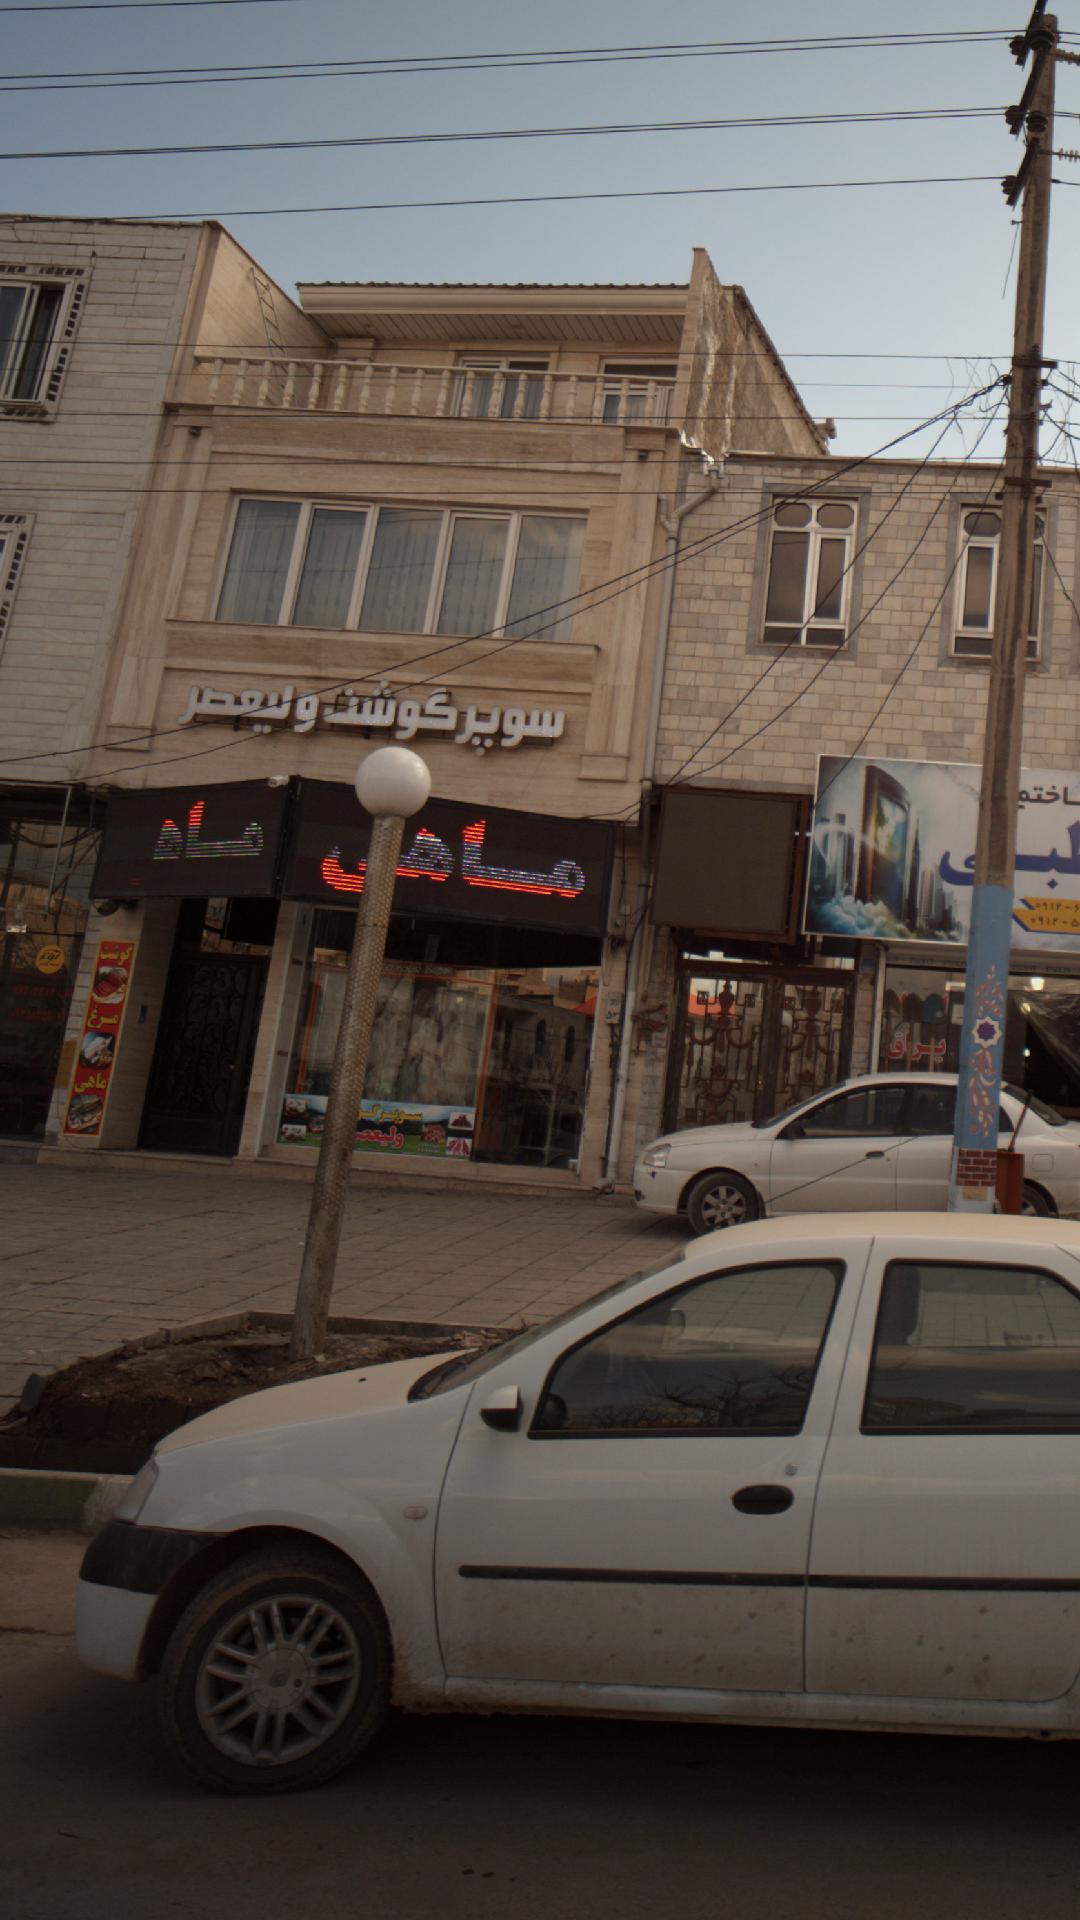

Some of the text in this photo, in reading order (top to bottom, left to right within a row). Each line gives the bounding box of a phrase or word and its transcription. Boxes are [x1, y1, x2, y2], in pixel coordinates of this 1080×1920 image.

[177, 680, 568, 757] سوپر گوشت ولیعصر
[320, 818, 587, 900] ماهی
[100, 945, 133, 966] گوشت
[88, 1008, 119, 1028] مرغ
[74, 1072, 107, 1093] ماهی
